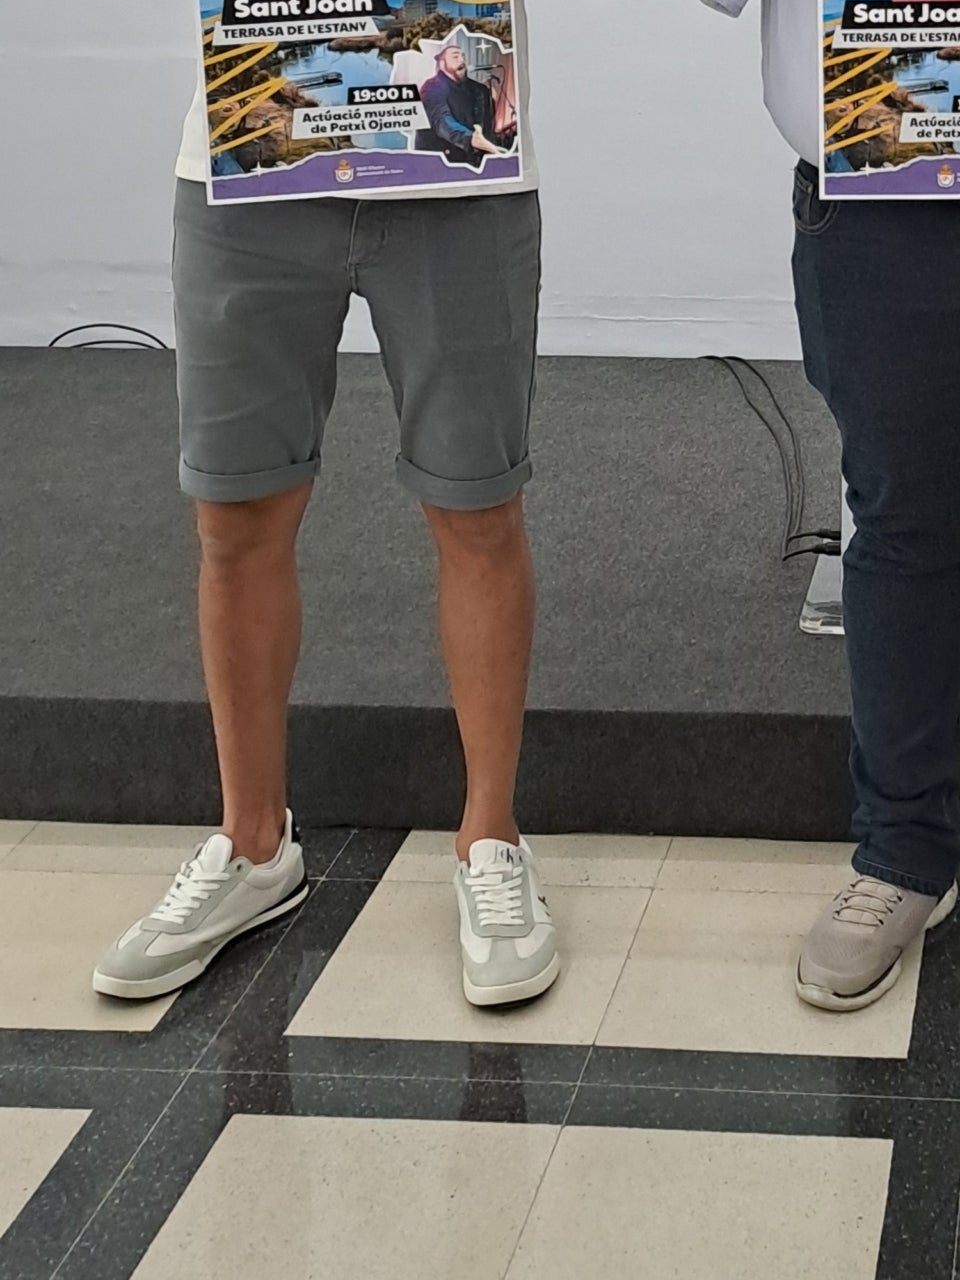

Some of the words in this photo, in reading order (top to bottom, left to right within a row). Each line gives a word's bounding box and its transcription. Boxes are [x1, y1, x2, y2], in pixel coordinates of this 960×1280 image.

[853, 3, 914, 24] Sant
[223, 26, 284, 39] TERRASA
[287, 25, 304, 36] DE
[842, 32, 897, 42] TERRASA
[901, 32, 917, 42] DE
[353, 88, 399, 103] 19:00
[402, 87, 414, 99] h
[364, 106, 418, 119] musical
[311, 124, 327, 134] de
[331, 120, 366, 132] Patxi
[369, 120, 411, 131] Ojana
[916, 129, 932, 138] de
